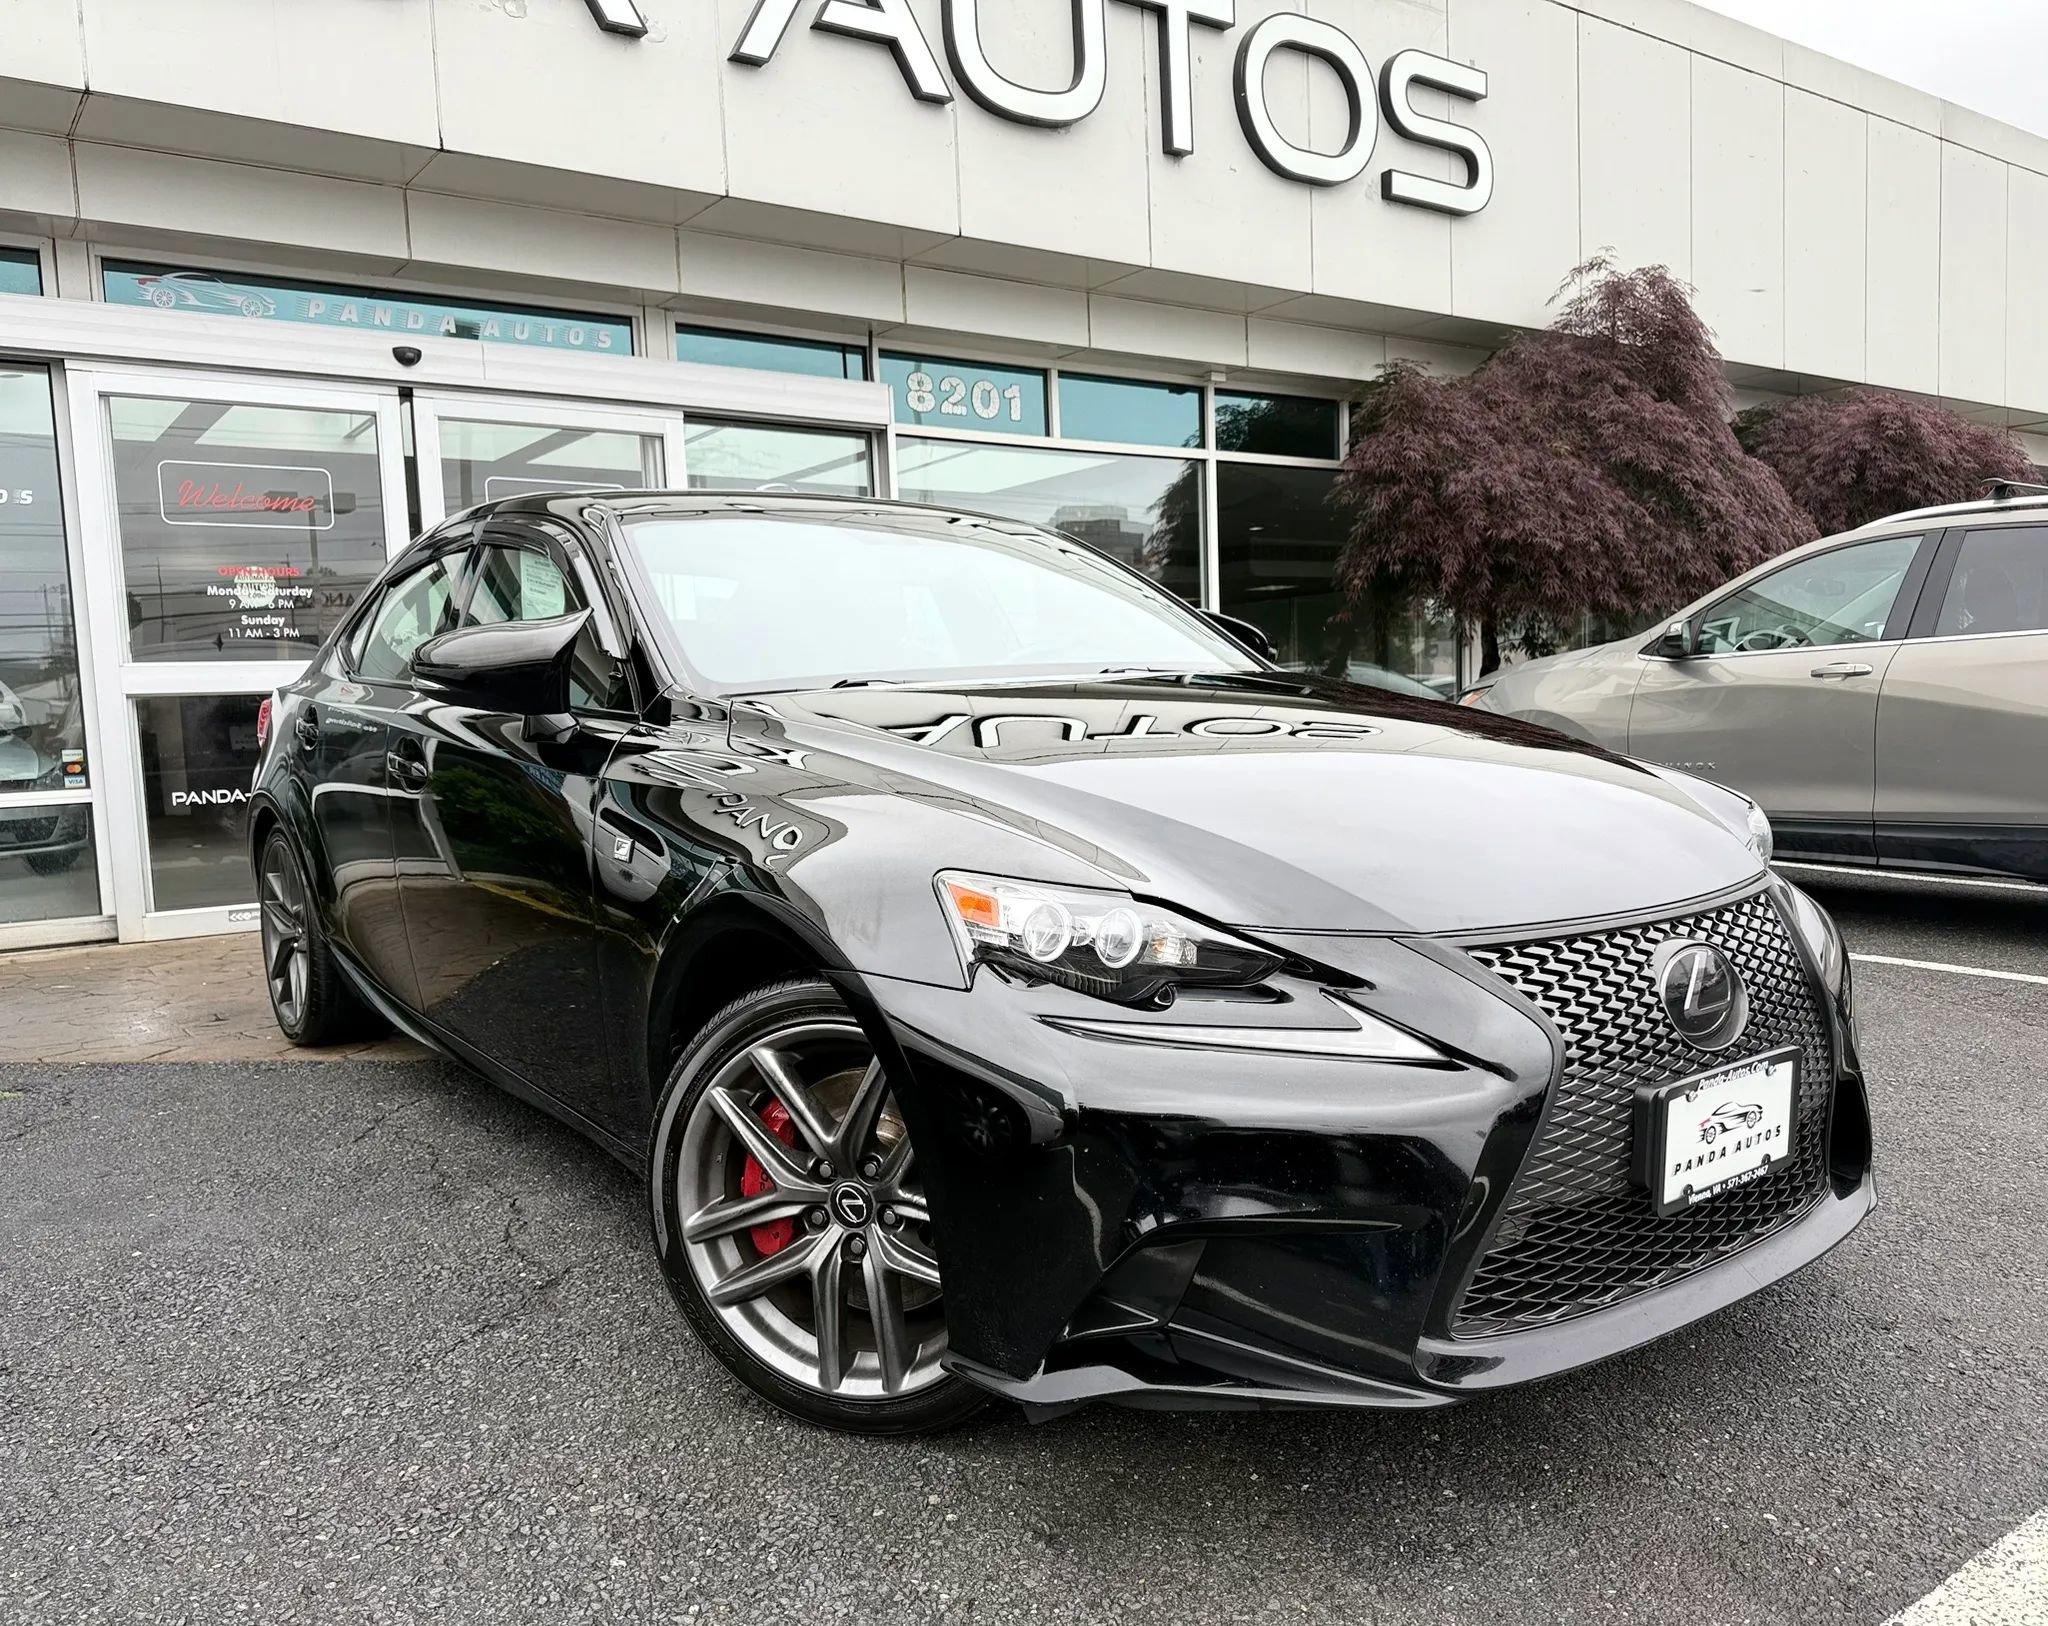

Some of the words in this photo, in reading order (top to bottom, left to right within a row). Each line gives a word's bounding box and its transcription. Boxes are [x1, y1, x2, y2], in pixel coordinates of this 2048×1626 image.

[304, 298, 457, 334] PANDA
[480, 319, 613, 349] AUTOS
[905, 371, 1022, 422] 8201
[178, 479, 316, 512] Welcome
[218, 566, 251, 577] OPEN
[257, 567, 300, 577] HOURS
[229, 599, 236, 609] 9
[278, 599, 295, 609] PM
[241, 614, 286, 627] Sunday
[228, 627, 241, 638] 11
[245, 628, 263, 638] AM
[273, 628, 280, 638] 3
[283, 628, 300, 638] PM
[1672, 1146, 1727, 1176] PANDA
[1734, 1125, 1781, 1154] AUTOS
